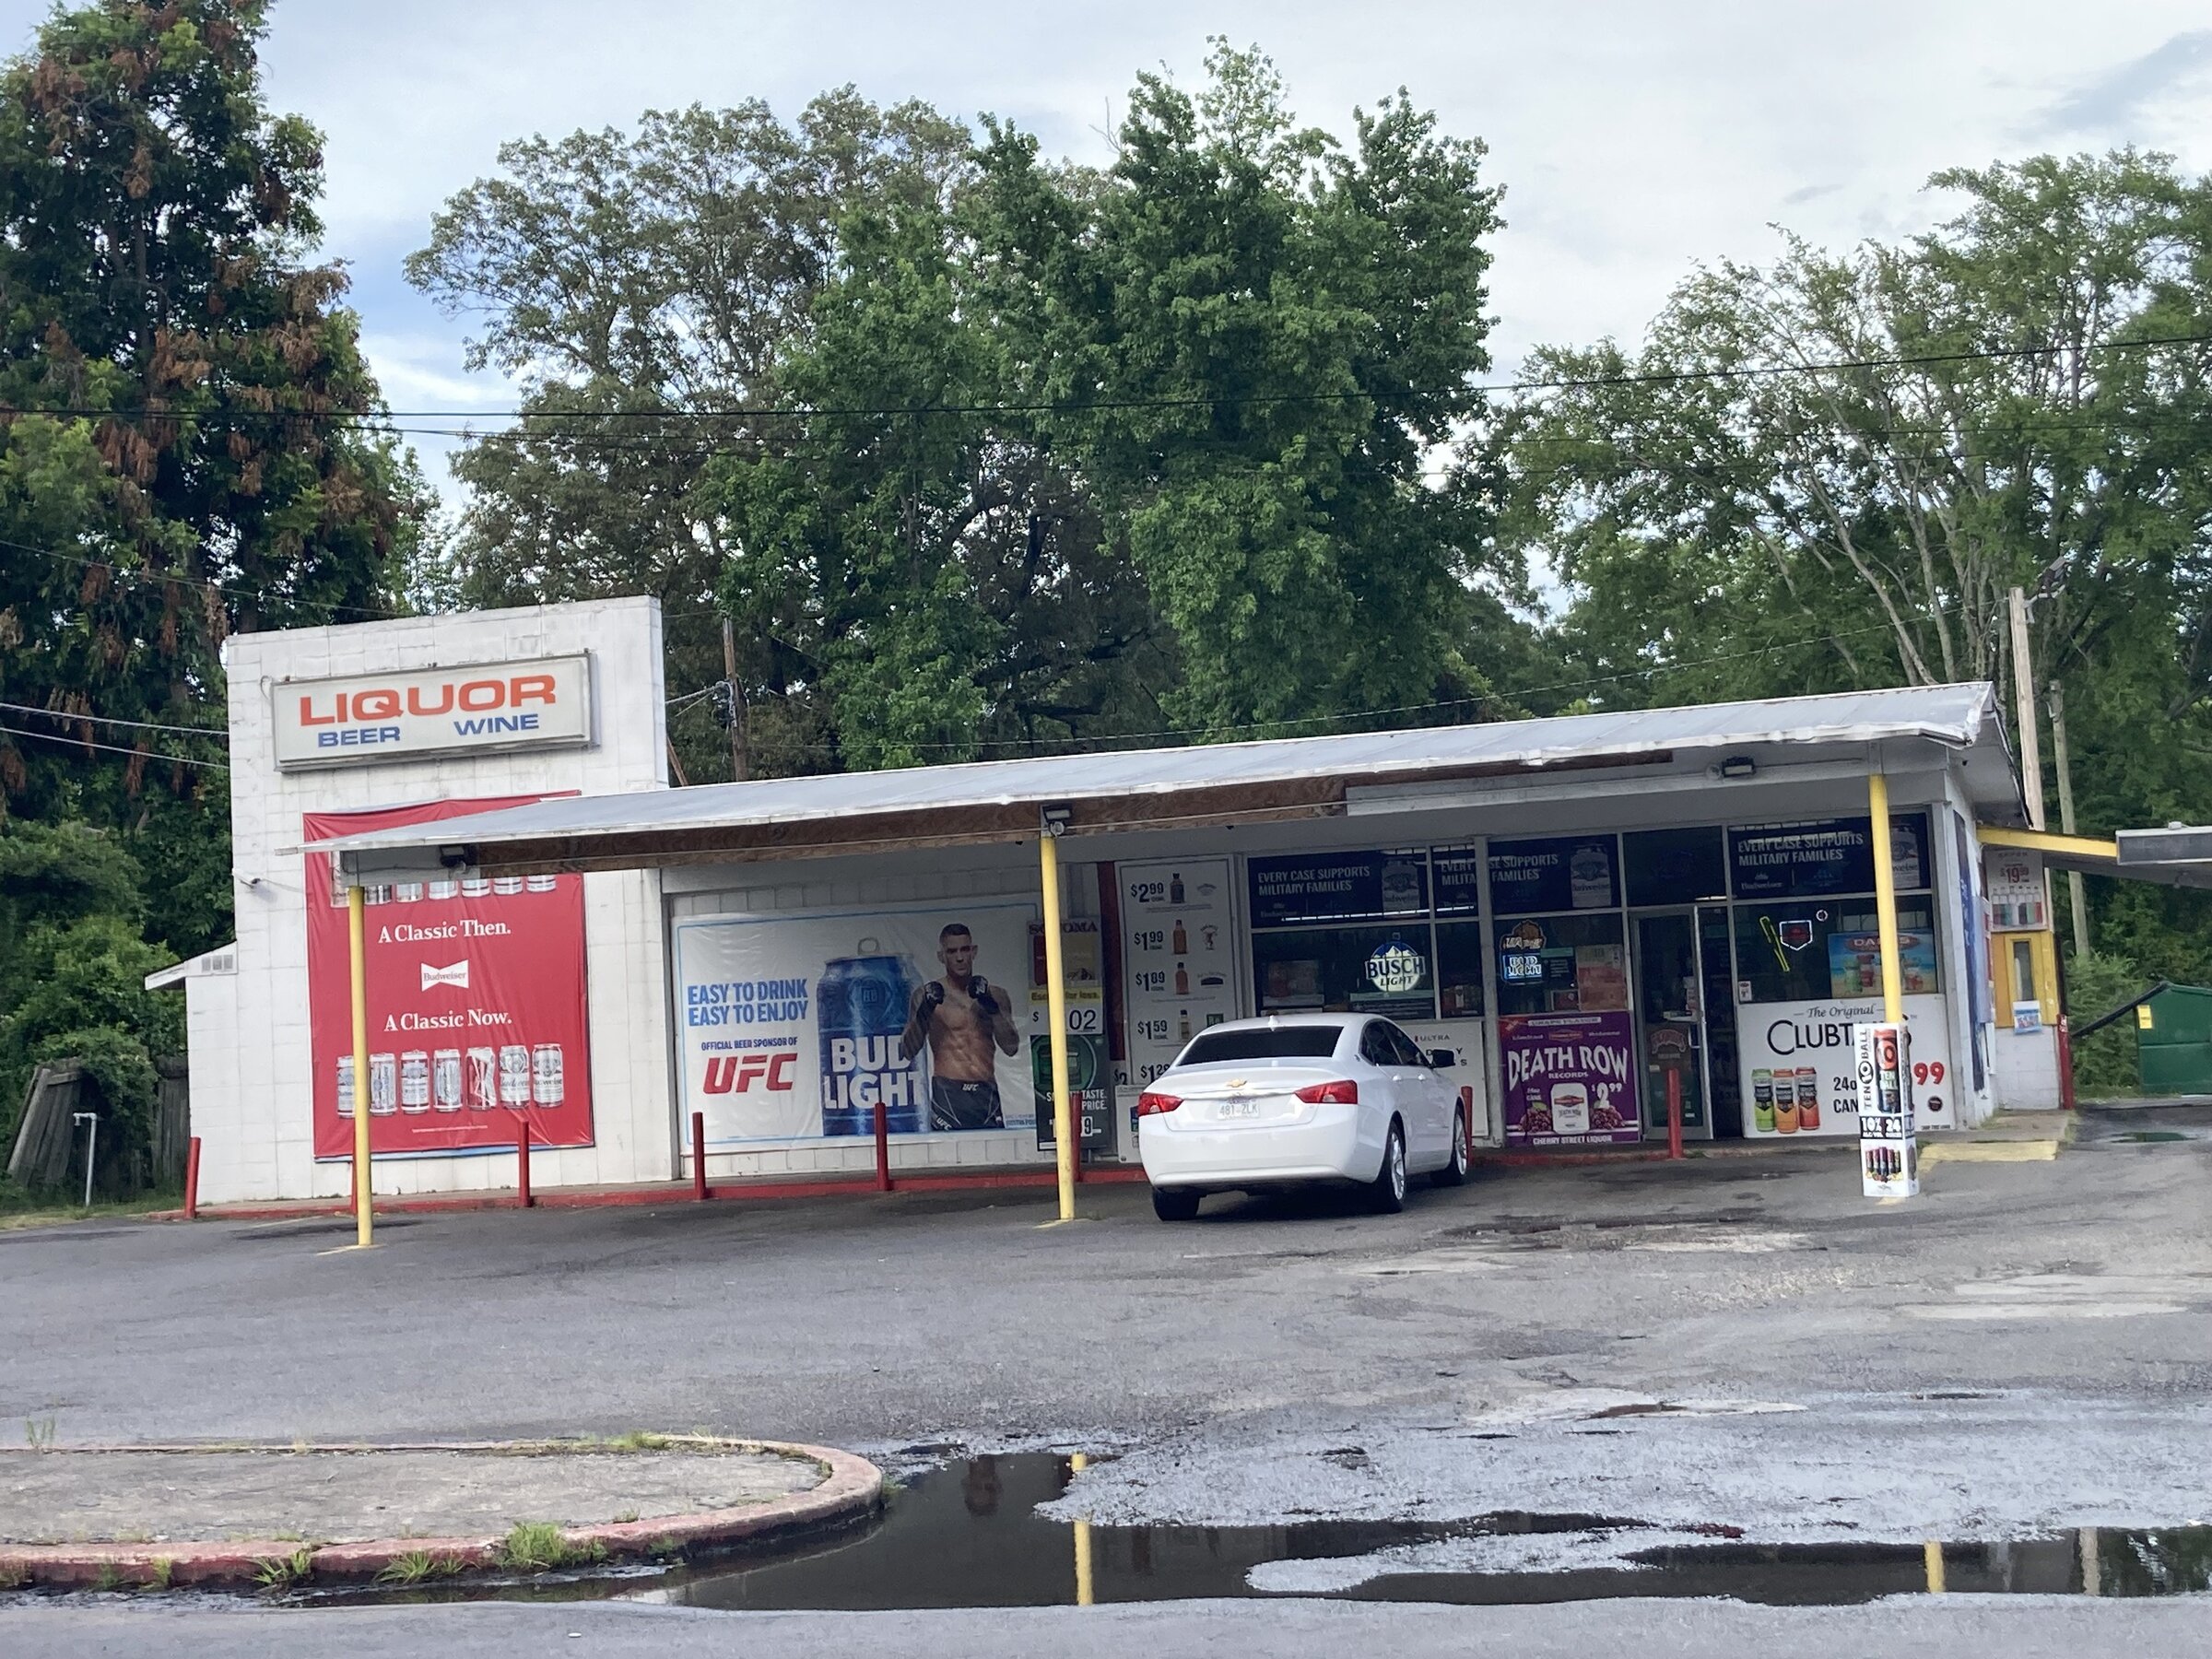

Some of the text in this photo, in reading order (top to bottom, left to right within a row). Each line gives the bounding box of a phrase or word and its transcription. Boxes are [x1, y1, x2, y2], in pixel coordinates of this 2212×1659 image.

[300, 675, 556, 726] LIQUOR
[318, 713, 539, 747] BEER WINE
[1737, 833, 1864, 853] EVERY CASE SUPPORTS
[1503, 853, 1559, 869] SUPPORTS
[1738, 848, 1843, 866] MILITARY FAMILIES
[1257, 866, 1370, 883] EVERY CASE SUPPORTS
[1442, 869, 1540, 886] MILITA FAMILIES
[1259, 879, 1352, 896] MILITARY FAMILIES
[378, 919, 512, 943] A Classic Then.
[423, 971, 466, 982] Budweiser
[1367, 957, 1423, 979] BUSCH
[1380, 975, 1414, 986] LIGHT
[688, 979, 807, 1005] EASY TO DRINK
[383, 1008, 512, 1031] A Classic Now.
[688, 1000, 808, 1026] EASY TO ENJOY
[1807, 1005, 1875, 1019] The Original
[701, 1037, 798, 1051] OFFICIAL BEER SPONSOR OF
[1419, 1034, 1451, 1042] ULTRA
[1860, 1029, 1869, 1059] BALL
[831, 1035, 912, 1073] BUD
[703, 1053, 798, 1095] UFC
[1508, 1045, 1628, 1091] DEATH ROW
[1548, 1071, 1589, 1079] RECORDS
[824, 1071, 923, 1110] LIGHT
[962, 1083, 979, 1091] UFC
[1833, 1077, 1857, 1091] 24o
[1082, 1088, 1107, 1100] TASTE.
[1863, 1086, 1872, 1110] TEN
[1082, 1100, 1107, 1111] PRICE.
[936, 1116, 953, 1131] UFC
[1862, 1117, 1901, 1132] 10% 24
[1533, 1135, 1612, 1145] CHERRY STREET LIQUOR
